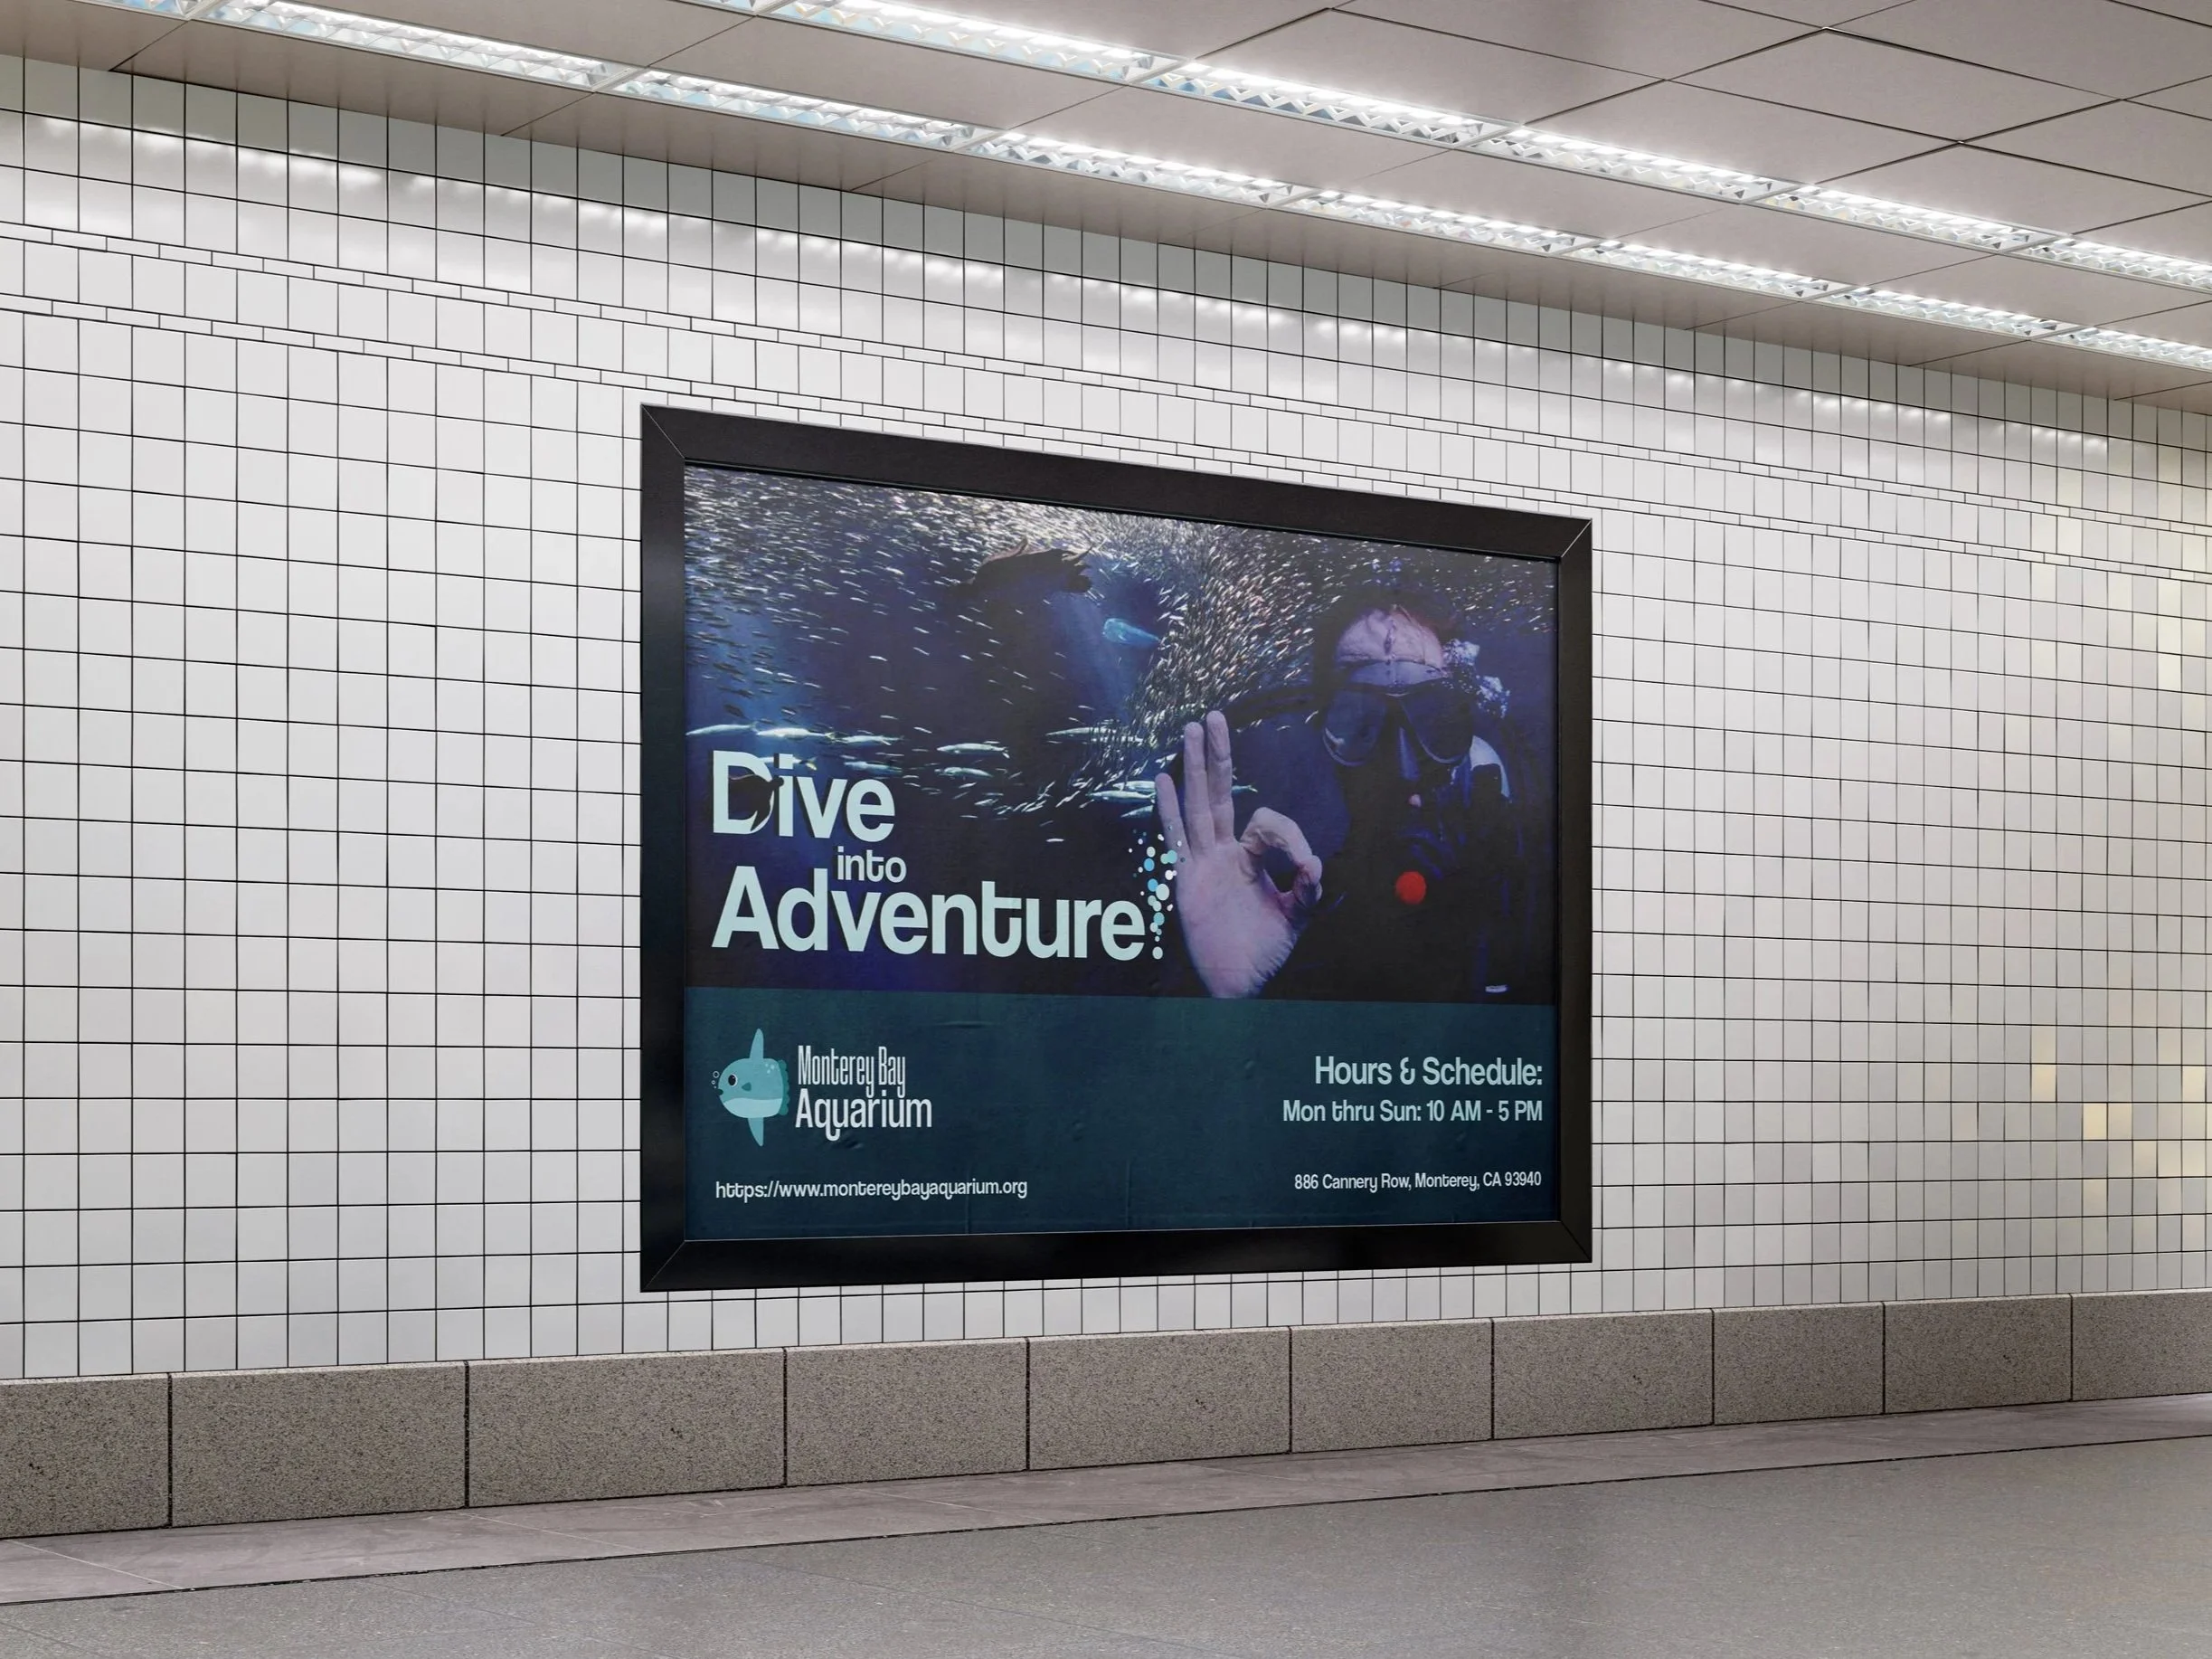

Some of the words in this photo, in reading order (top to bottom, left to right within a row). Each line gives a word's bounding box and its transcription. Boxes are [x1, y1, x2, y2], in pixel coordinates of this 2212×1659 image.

[713, 750, 895, 842] Dive
[837, 846, 906, 883] into
[798, 1045, 874, 1098] Monterey
[878, 1046, 906, 1097] Bay
[1315, 1056, 1392, 1085] Hours
[1400, 1057, 1415, 1085] &
[1423, 1057, 1543, 1085] Schedule:
[795, 1088, 932, 1142] Aquarium
[1282, 1100, 1325, 1122] Mon
[1332, 1100, 1374, 1122] thru
[1380, 1100, 1422, 1122] Sun:
[1426, 1100, 1444, 1122] 10
[1451, 1100, 1481, 1121] AM
[1498, 1100, 1509, 1121] 5
[1515, 1101, 1543, 1121] PM
[715, 1179, 1027, 1203] https://www.montereybayaquarium.org
[1294, 1174, 1319, 1190] 886
[1322, 1174, 1377, 1193] Cannery
[1382, 1173, 1412, 1190] Row,
[1415, 1173, 1479, 1192] Monterey,
[1483, 1173, 1501, 1187] CA
[1505, 1171, 1542, 1187] 93940
